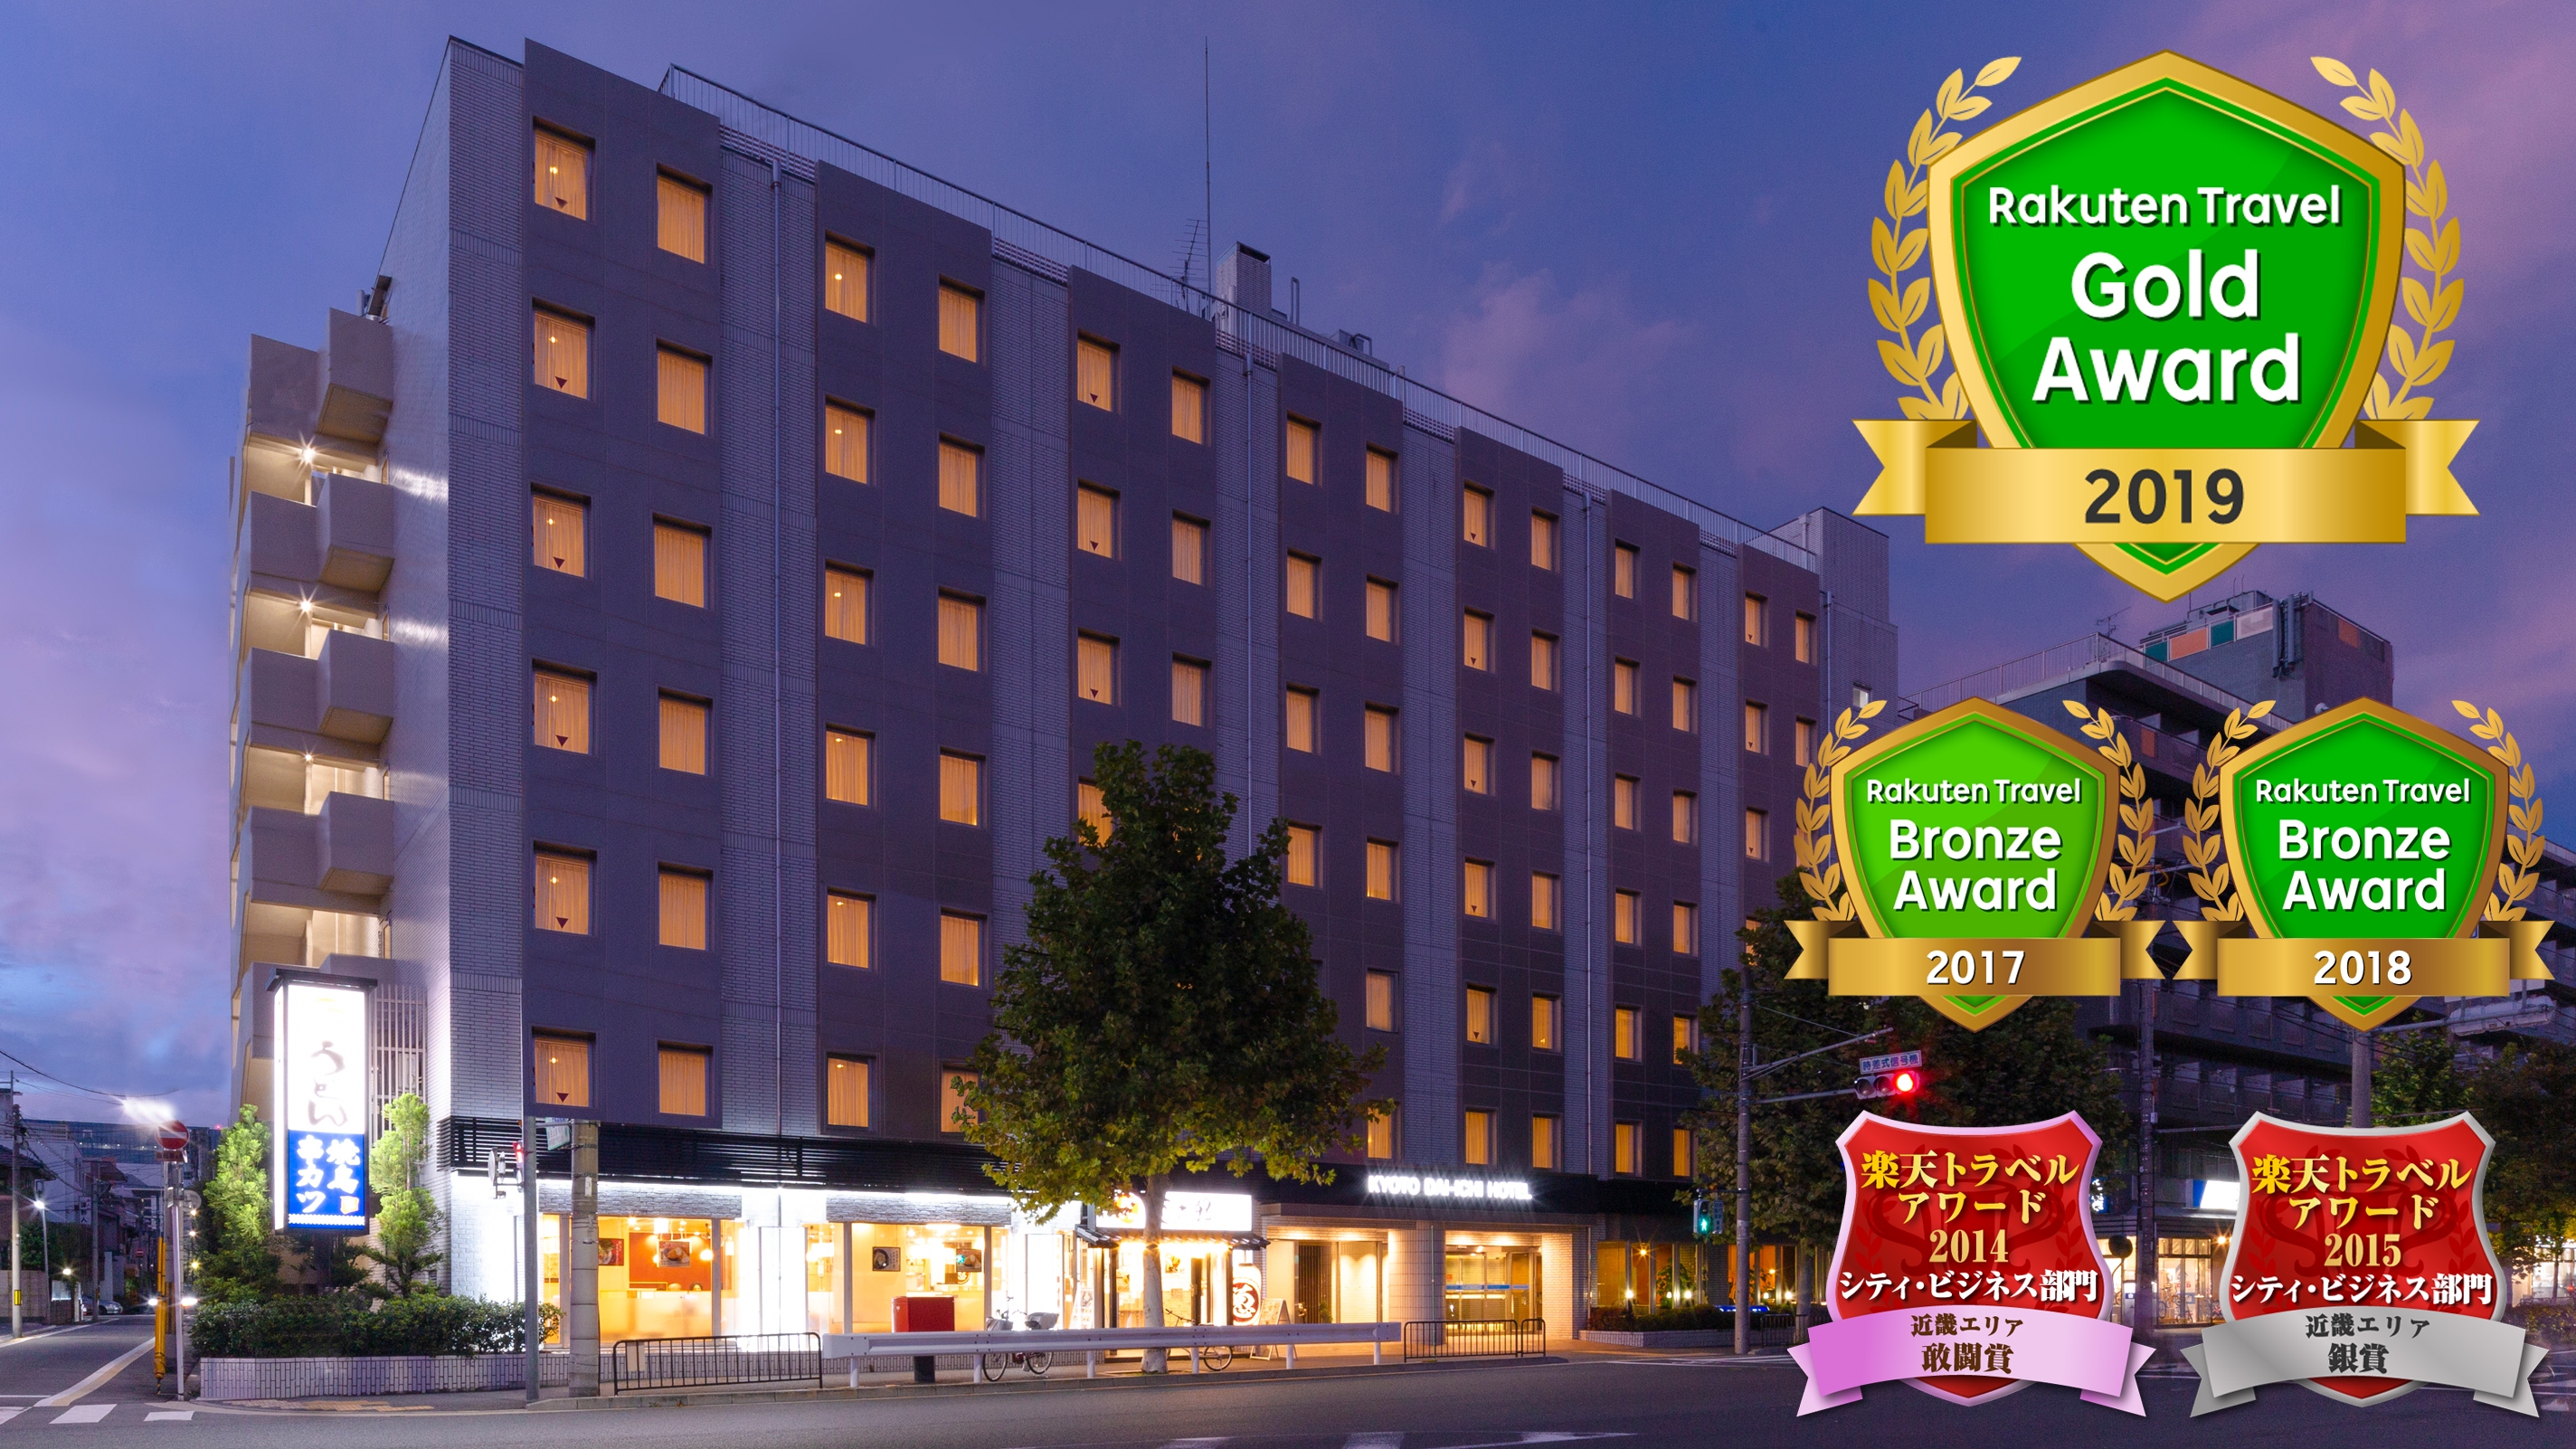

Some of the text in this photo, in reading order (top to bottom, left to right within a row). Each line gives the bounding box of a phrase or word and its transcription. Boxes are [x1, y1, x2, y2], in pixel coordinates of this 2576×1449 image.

[1862, 1055, 1918, 1071] 時差式信号機
[297, 1134, 326, 1214] 串カツ
[1368, 1175, 1532, 1200] KYOTO DAI-ICHI HOTEL
